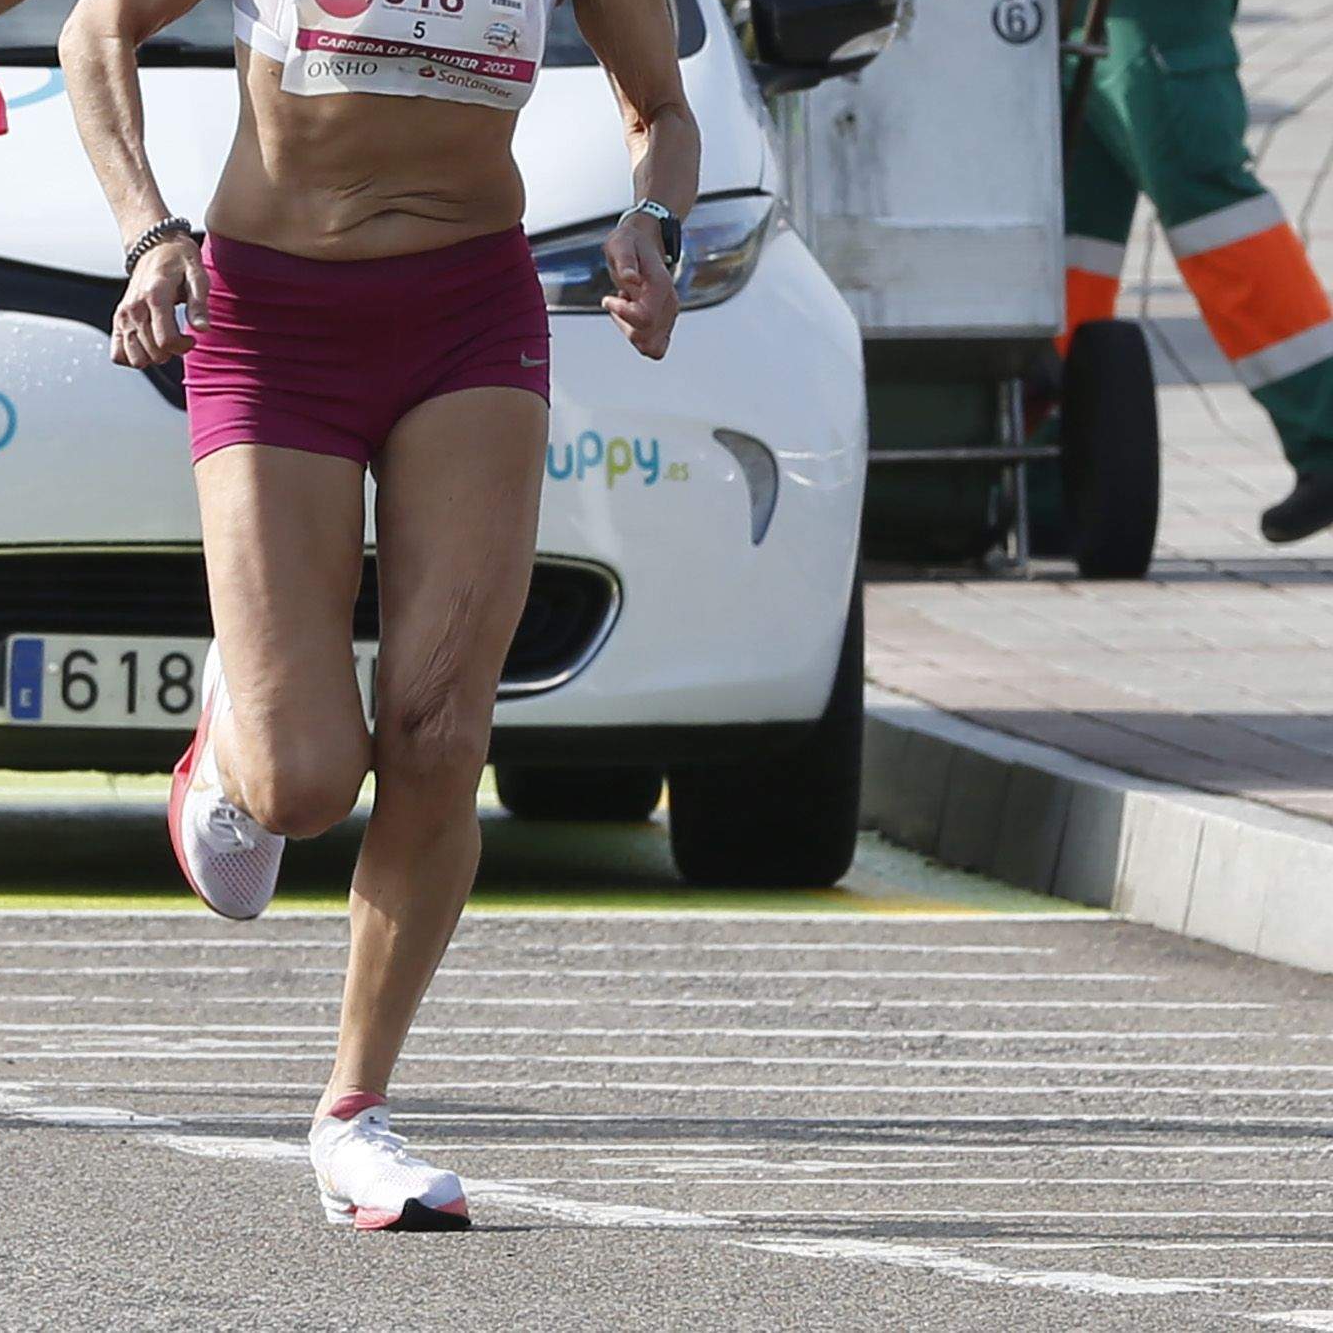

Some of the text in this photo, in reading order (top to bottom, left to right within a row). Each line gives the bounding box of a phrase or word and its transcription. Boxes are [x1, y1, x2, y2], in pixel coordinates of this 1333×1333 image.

[412, 20, 426, 39] 5
[308, 60, 378, 78] OYSHO
[317, 35, 385, 56] CARRERA
[483, 60, 516, 76] 2023
[437, 69, 513, 99] Santander
[546, 430, 690, 491] uppy.es
[18, 688, 32, 707] E
[60, 649, 195, 716] 618
